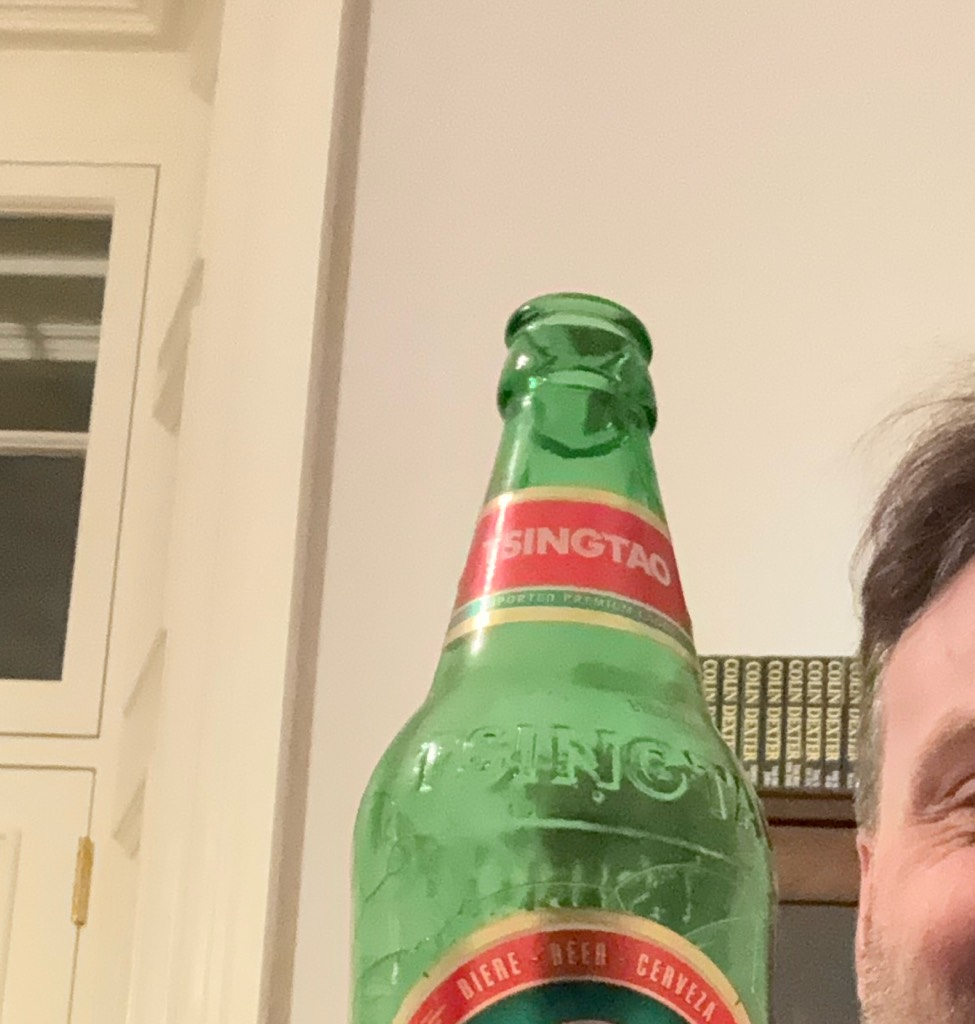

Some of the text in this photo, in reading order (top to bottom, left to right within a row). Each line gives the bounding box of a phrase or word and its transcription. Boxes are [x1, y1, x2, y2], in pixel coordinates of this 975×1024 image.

[703, 659, 718, 702] COLIN
[723, 657, 739, 702] COLIN
[744, 661, 762, 704] COLIN
[767, 660, 784, 704] COLIN
[788, 659, 804, 703] COLIN
[807, 660, 823, 704] COLIN
[826, 660, 843, 704] COLIN
[743, 707, 760, 761] DEXTER
[765, 706, 782, 761] DEXTER
[785, 706, 803, 760] DEXTER
[805, 707, 822, 761] DEXTER
[825, 707, 842, 761] DEXTER
[549, 940, 607, 967] BEER
[636, 952, 717, 1023] CERVEZA
